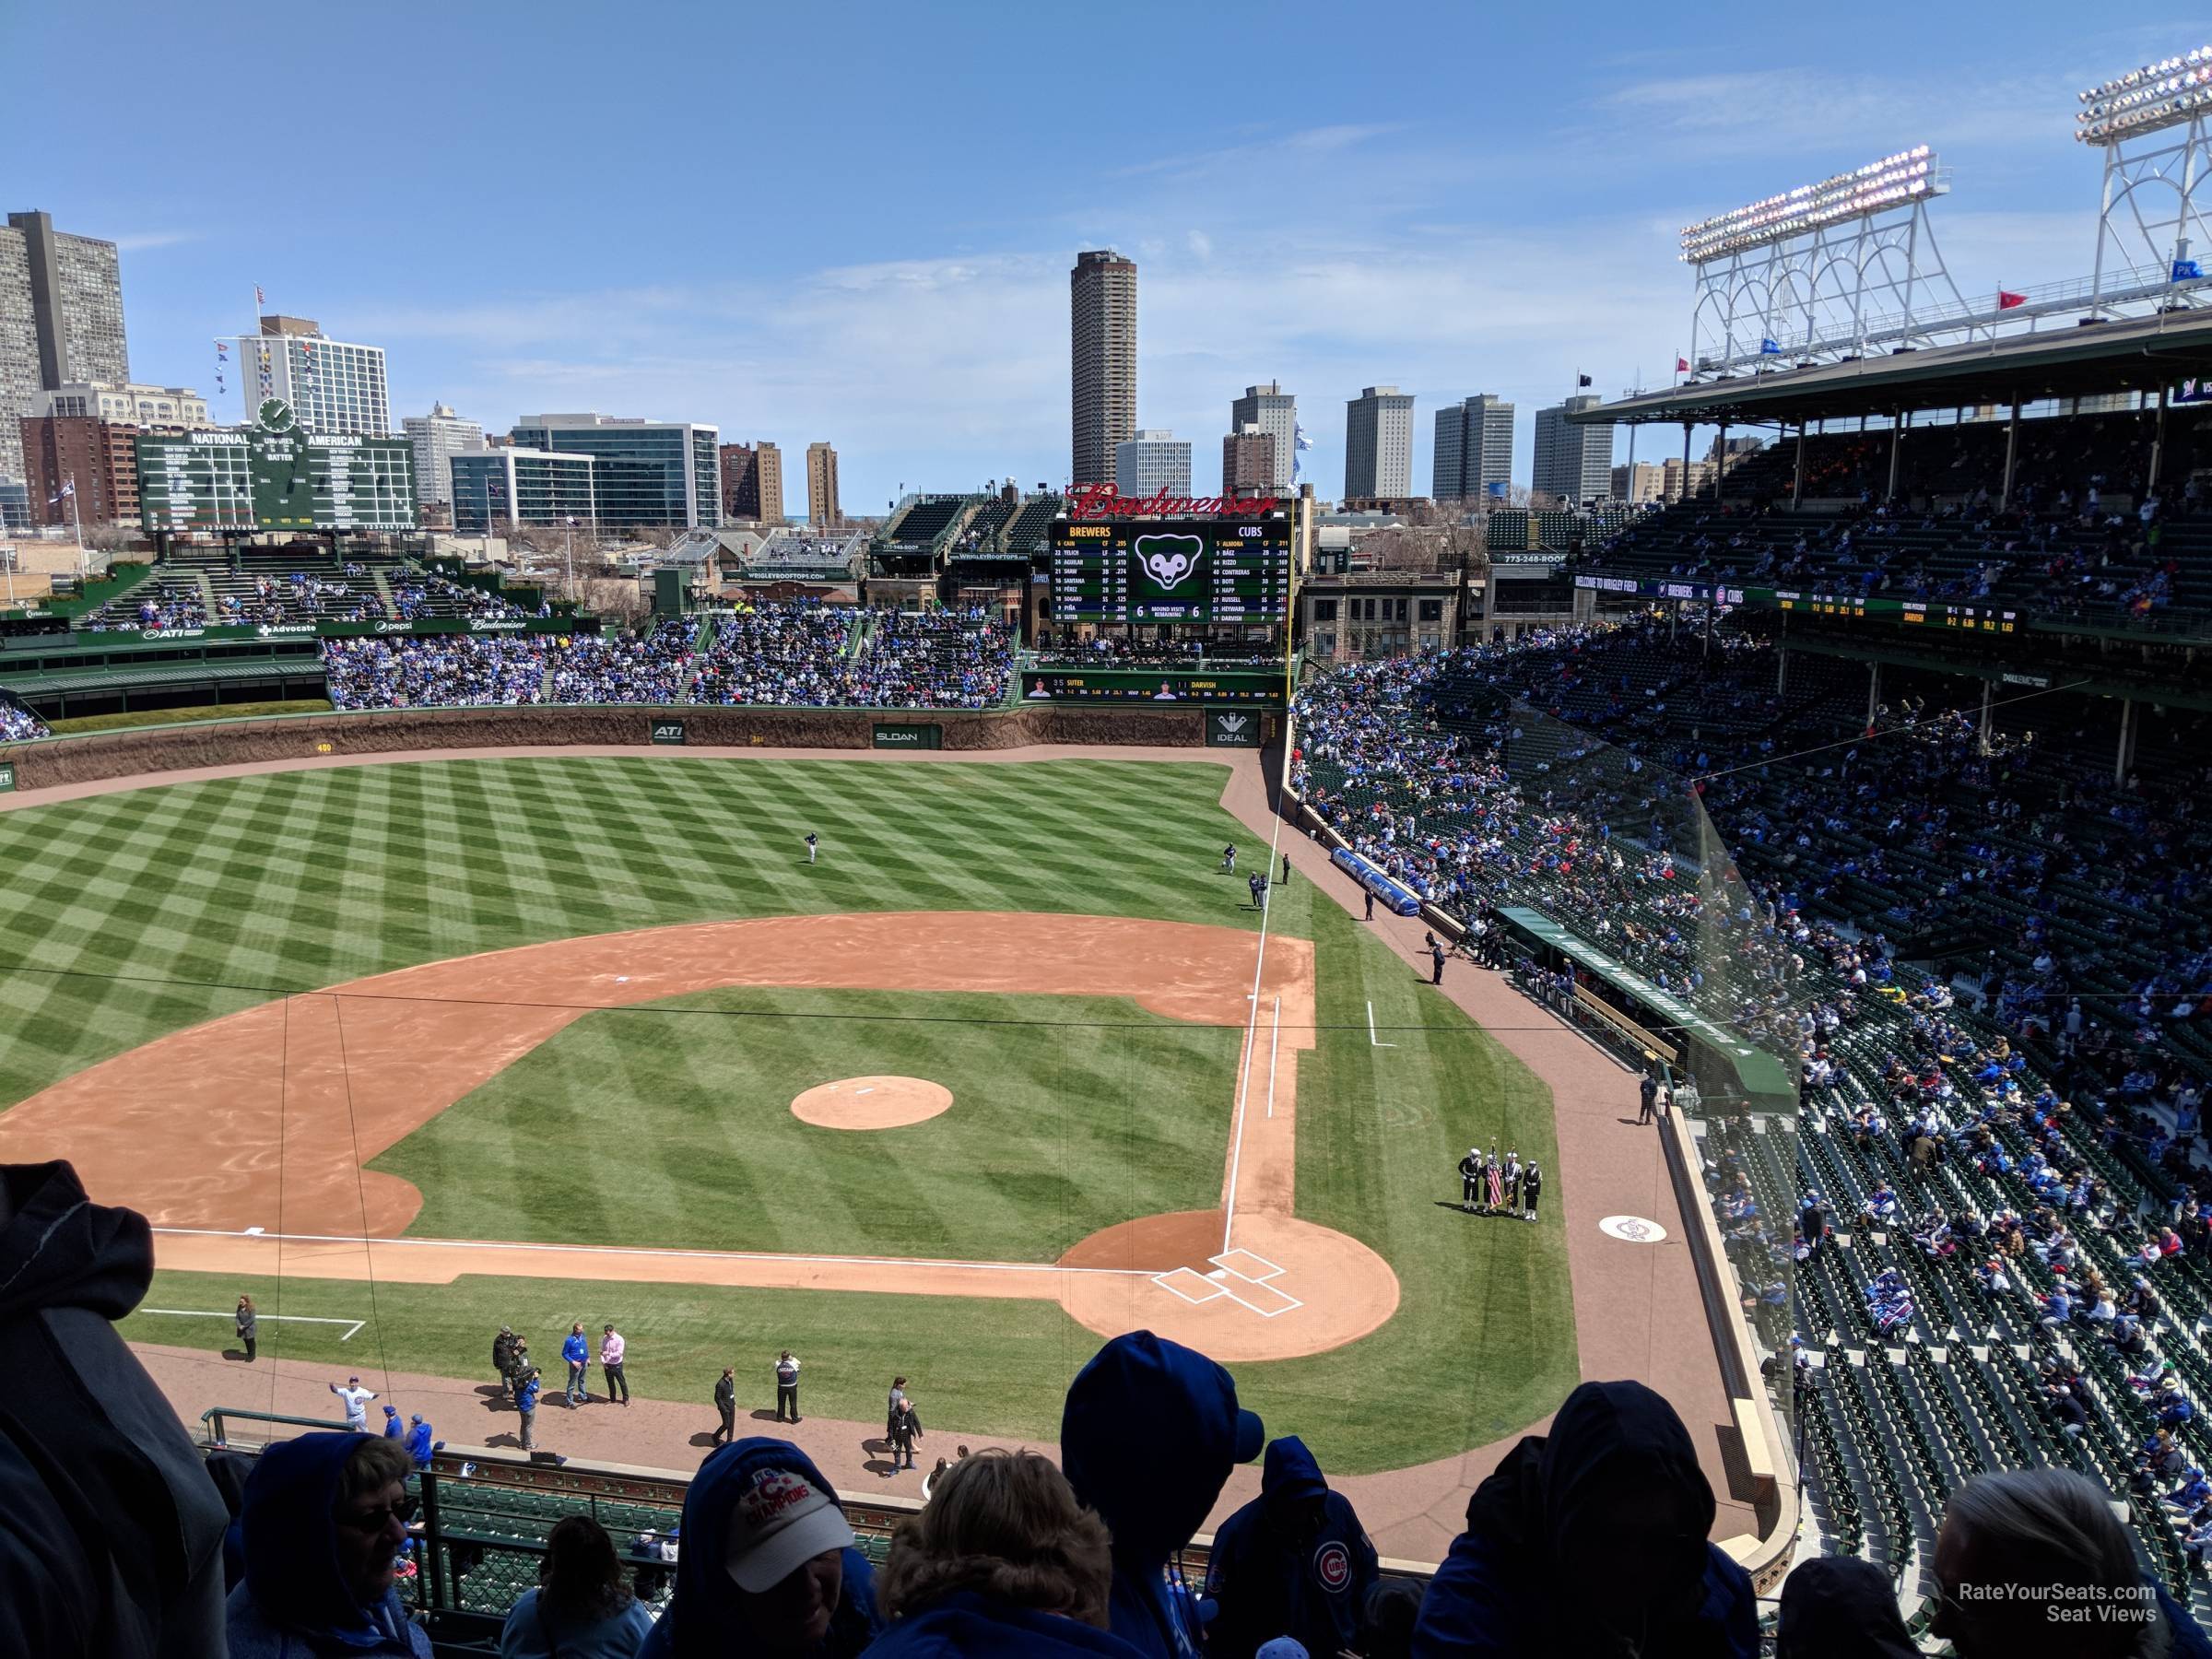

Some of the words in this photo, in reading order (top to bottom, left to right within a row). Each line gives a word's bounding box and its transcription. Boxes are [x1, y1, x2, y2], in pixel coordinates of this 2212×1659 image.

[193, 433, 251, 444] NATIONAL
[308, 436, 362, 447] AMERICAN
[1065, 483, 1280, 520] Budweiser
[1069, 527, 1111, 536] BREWERS
[1239, 526, 1263, 536] CUBS
[1505, 555, 1566, 563] 773-248-ROOF
[1575, 575, 1596, 589] WELCOME
[1596, 577, 1603, 589] TO
[1604, 578, 1623, 591] WRIGLEY
[1624, 580, 1637, 593] FIELD
[1668, 584, 1693, 598] BREWERS
[1727, 590, 1743, 603] CUBS
[1136, 606, 1144, 617] 6
[1193, 606, 1199, 618] 6
[272, 625, 316, 633] Advocate
[388, 622, 412, 631] pepsi
[470, 619, 527, 630] Budweiser
[159, 629, 183, 638] ATI
[654, 726, 683, 735] ATI
[877, 733, 917, 741] SLOAN
[318, 743, 332, 752] 400
